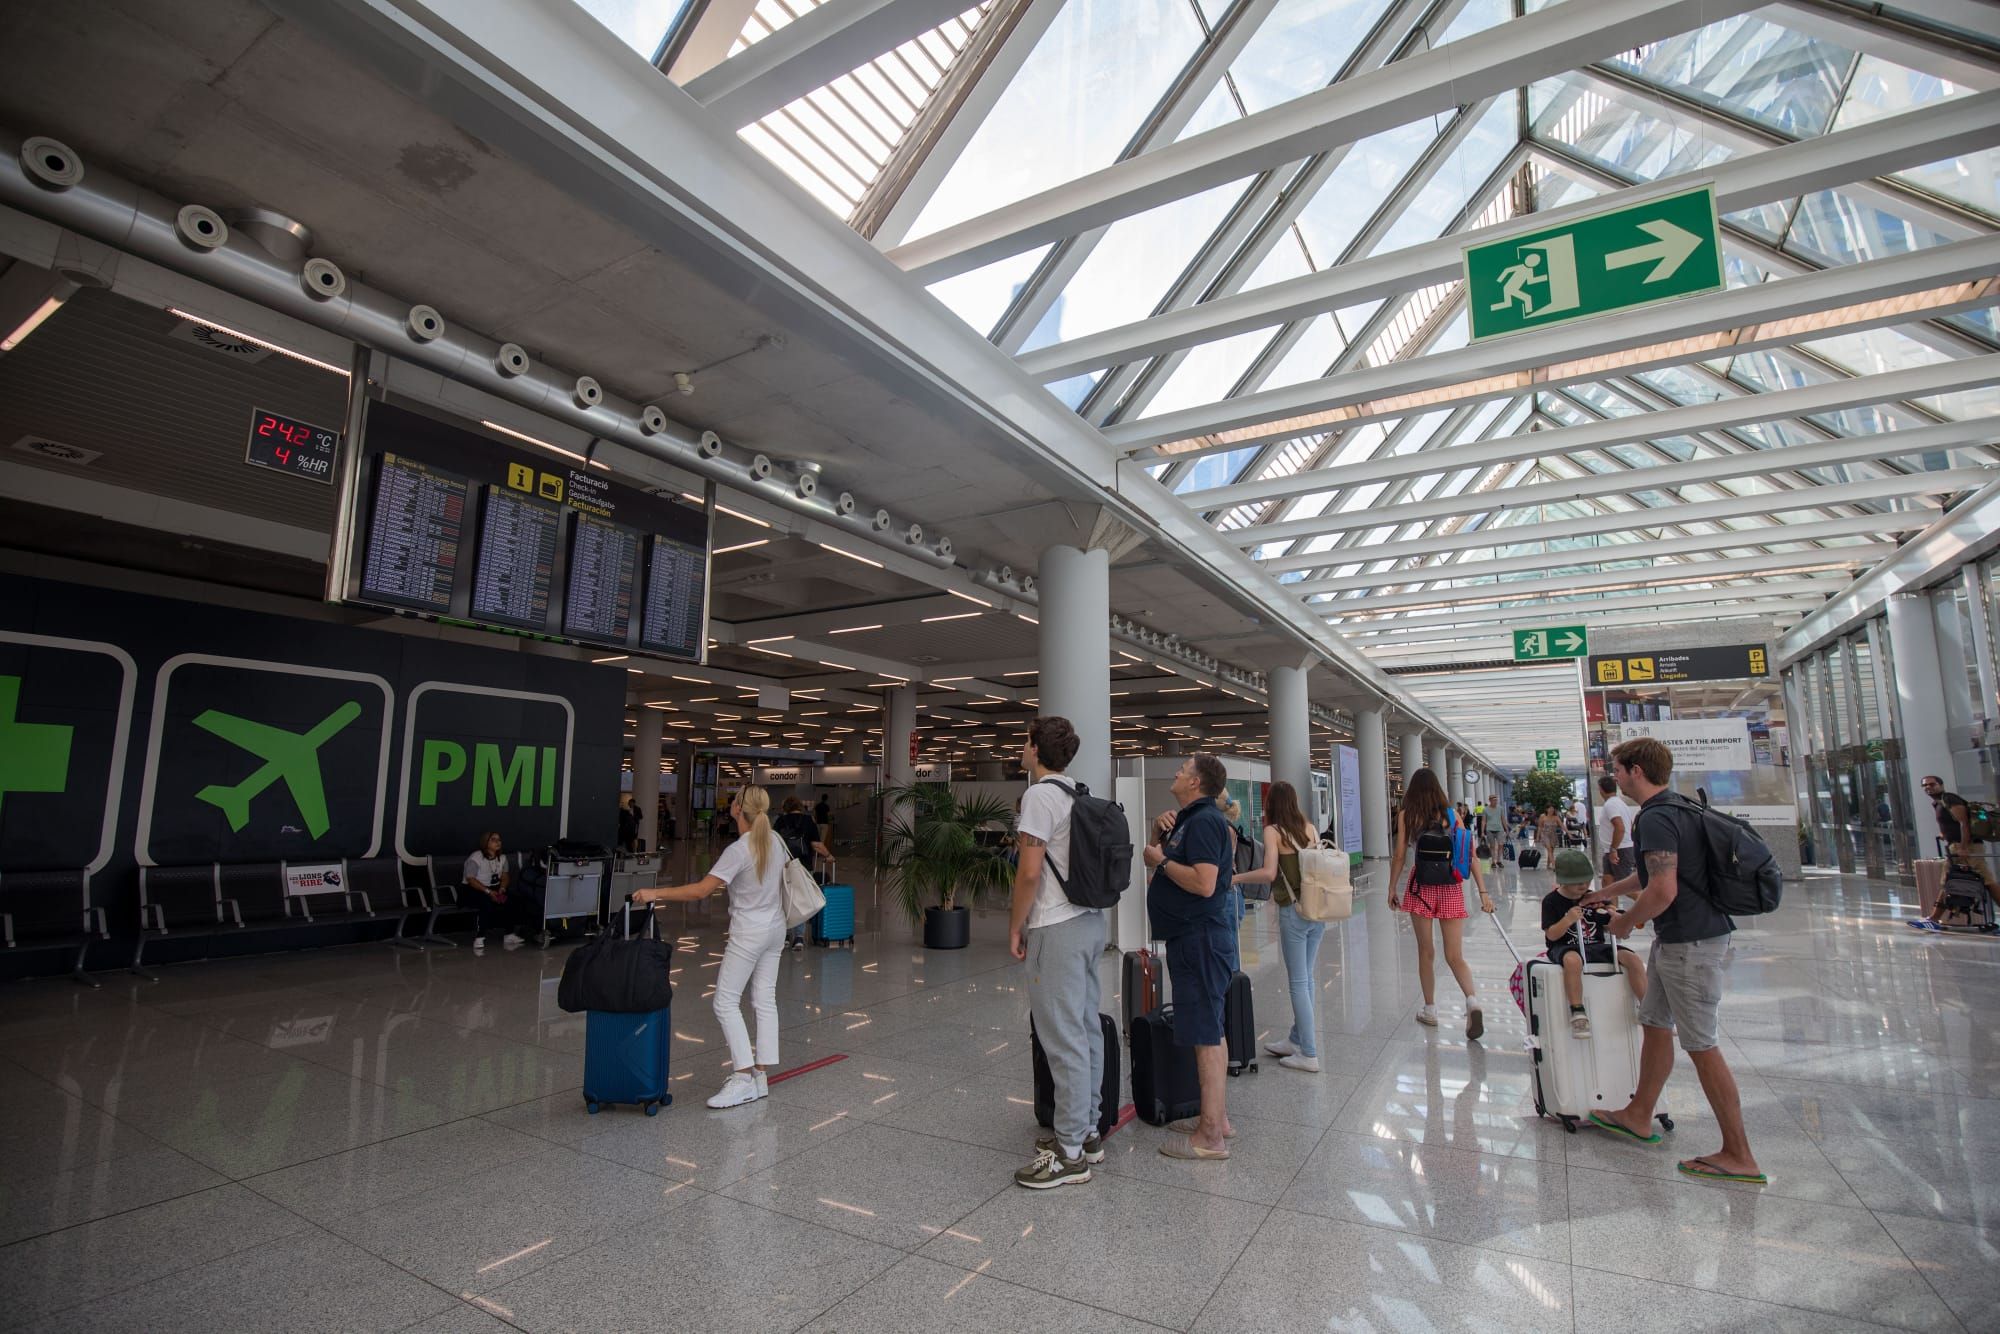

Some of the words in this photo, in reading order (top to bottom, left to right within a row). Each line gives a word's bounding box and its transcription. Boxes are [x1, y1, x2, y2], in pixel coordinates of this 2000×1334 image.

[258, 416, 311, 446] 24.2
[275, 447, 291, 465] 4
[298, 455, 328, 473] %HR
[568, 480, 597, 495] Check-in
[570, 470, 609, 490] Facturació
[567, 497, 611, 518] Facturación
[1662, 738, 1684, 746] ASTES
[1710, 737, 1742, 745] AIRPORT
[419, 739, 557, 807] PMI
[769, 770, 798, 780] condor
[299, 872, 322, 880] LIONS
[300, 879, 323, 887] RIRE
